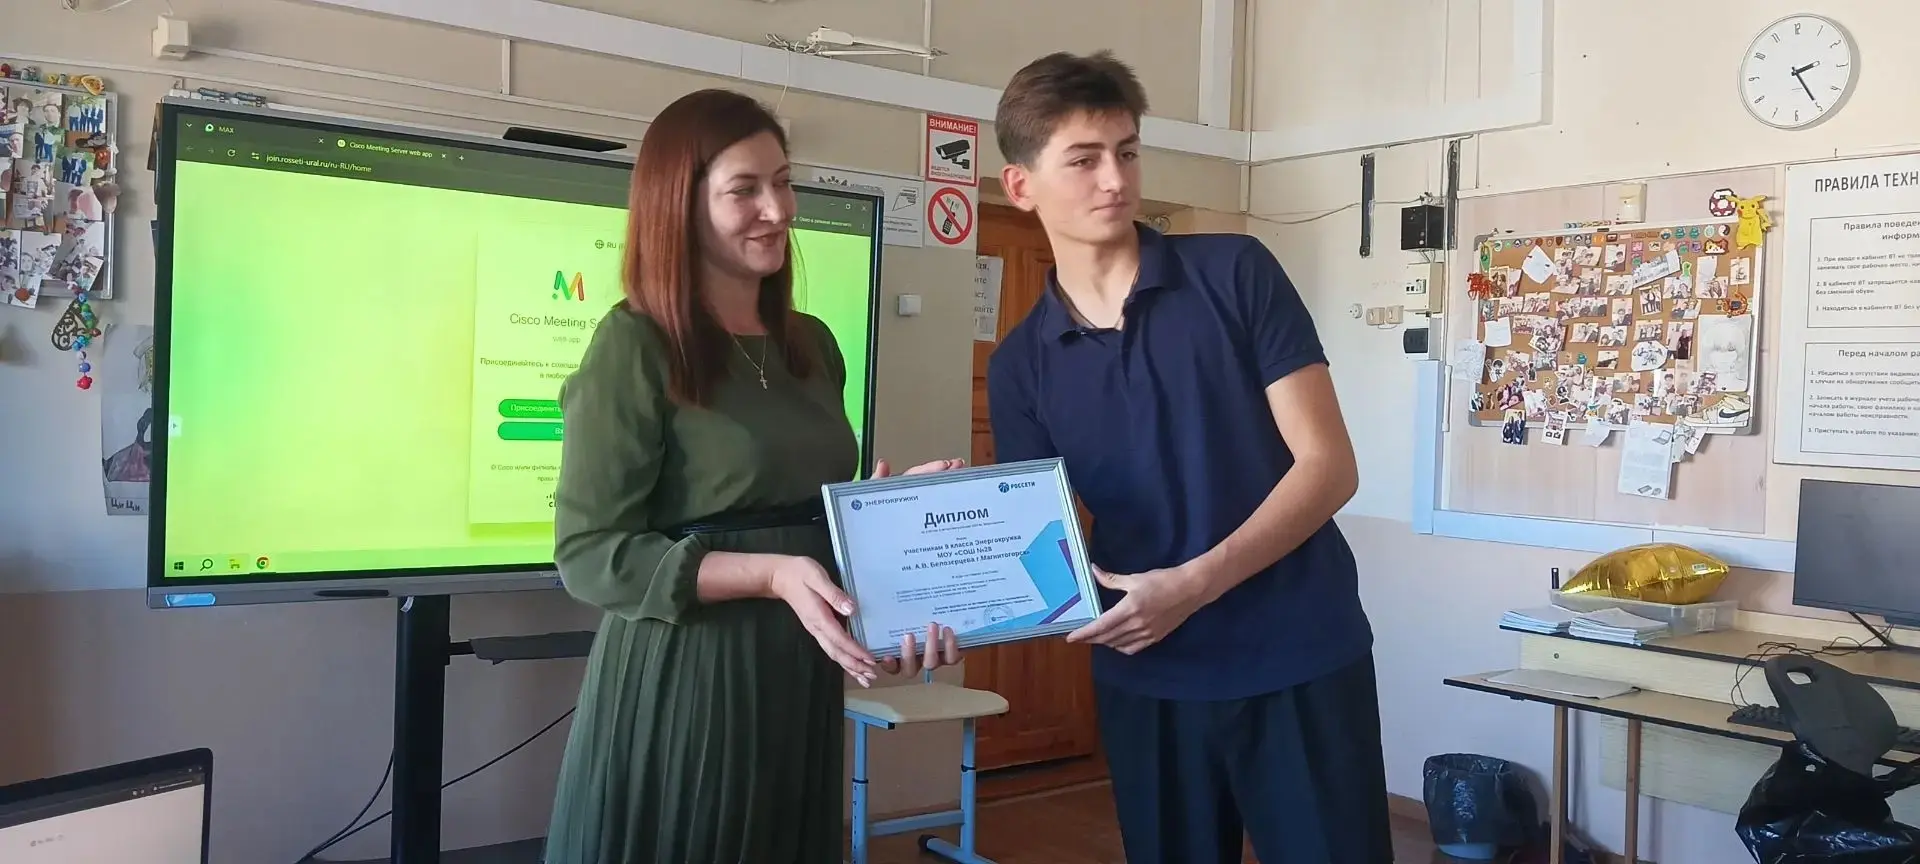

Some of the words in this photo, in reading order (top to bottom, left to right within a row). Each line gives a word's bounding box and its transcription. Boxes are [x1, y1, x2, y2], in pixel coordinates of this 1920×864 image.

[930, 118, 976, 134] ВНИМАНИЕ!
[350, 142, 365, 150] Cisco
[366, 144, 390, 153] Meeting
[390, 146, 408, 154] Server
[1815, 174, 1879, 192] ПРАВИЛА
[1884, 171, 1920, 188] ТЕХН
[1844, 222, 1882, 230] Правила
[1882, 233, 1920, 241] информ
[510, 313, 540, 326] Cisco
[544, 315, 586, 330] Meeting
[1838, 350, 1866, 358] Перед
[1011, 481, 1036, 489] РОССЕТИ
[865, 495, 919, 507] ЭНЕРГОКРУЖКИ
[924, 508, 989, 529] Диплом
[903, 545, 943, 555] участникам
[975, 535, 1021, 546] Энергокружка
[931, 558, 975, 568] Белозерцева
